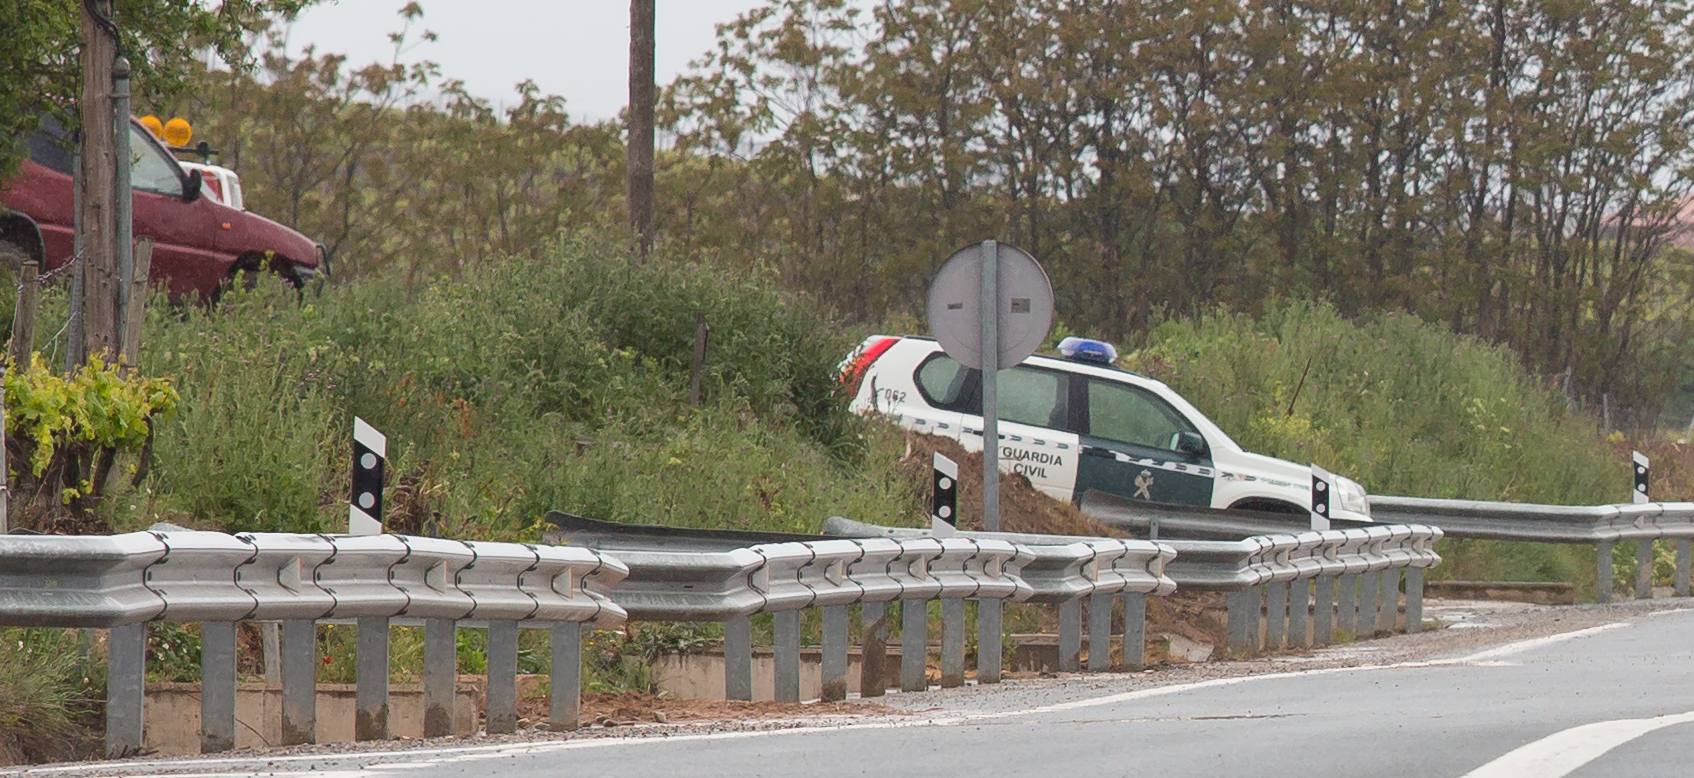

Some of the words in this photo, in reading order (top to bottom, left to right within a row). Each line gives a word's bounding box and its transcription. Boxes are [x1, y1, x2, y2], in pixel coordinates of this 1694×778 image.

[884, 388, 907, 403] 062
[1002, 446, 1063, 466] GUARDIA
[1013, 462, 1048, 479] CIVIL
